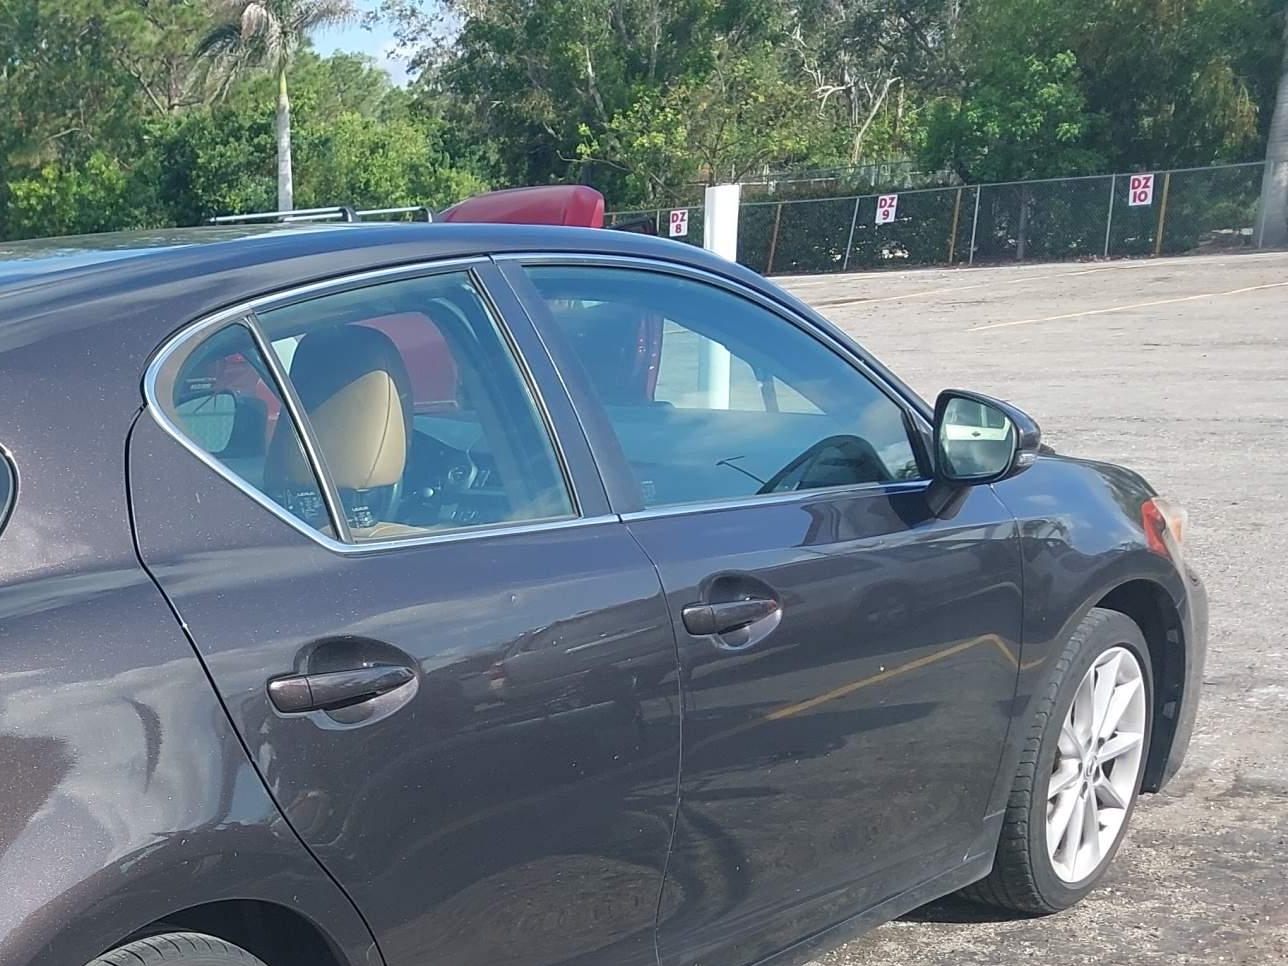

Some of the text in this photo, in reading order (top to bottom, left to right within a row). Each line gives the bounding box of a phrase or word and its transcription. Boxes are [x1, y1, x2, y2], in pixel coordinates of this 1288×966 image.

[1132, 176, 1152, 190] DZ
[1132, 190, 1148, 203] 10
[879, 197, 896, 209] DZ
[671, 211, 687, 223] DZ
[881, 209, 890, 221] 9
[675, 224, 682, 234] 8
